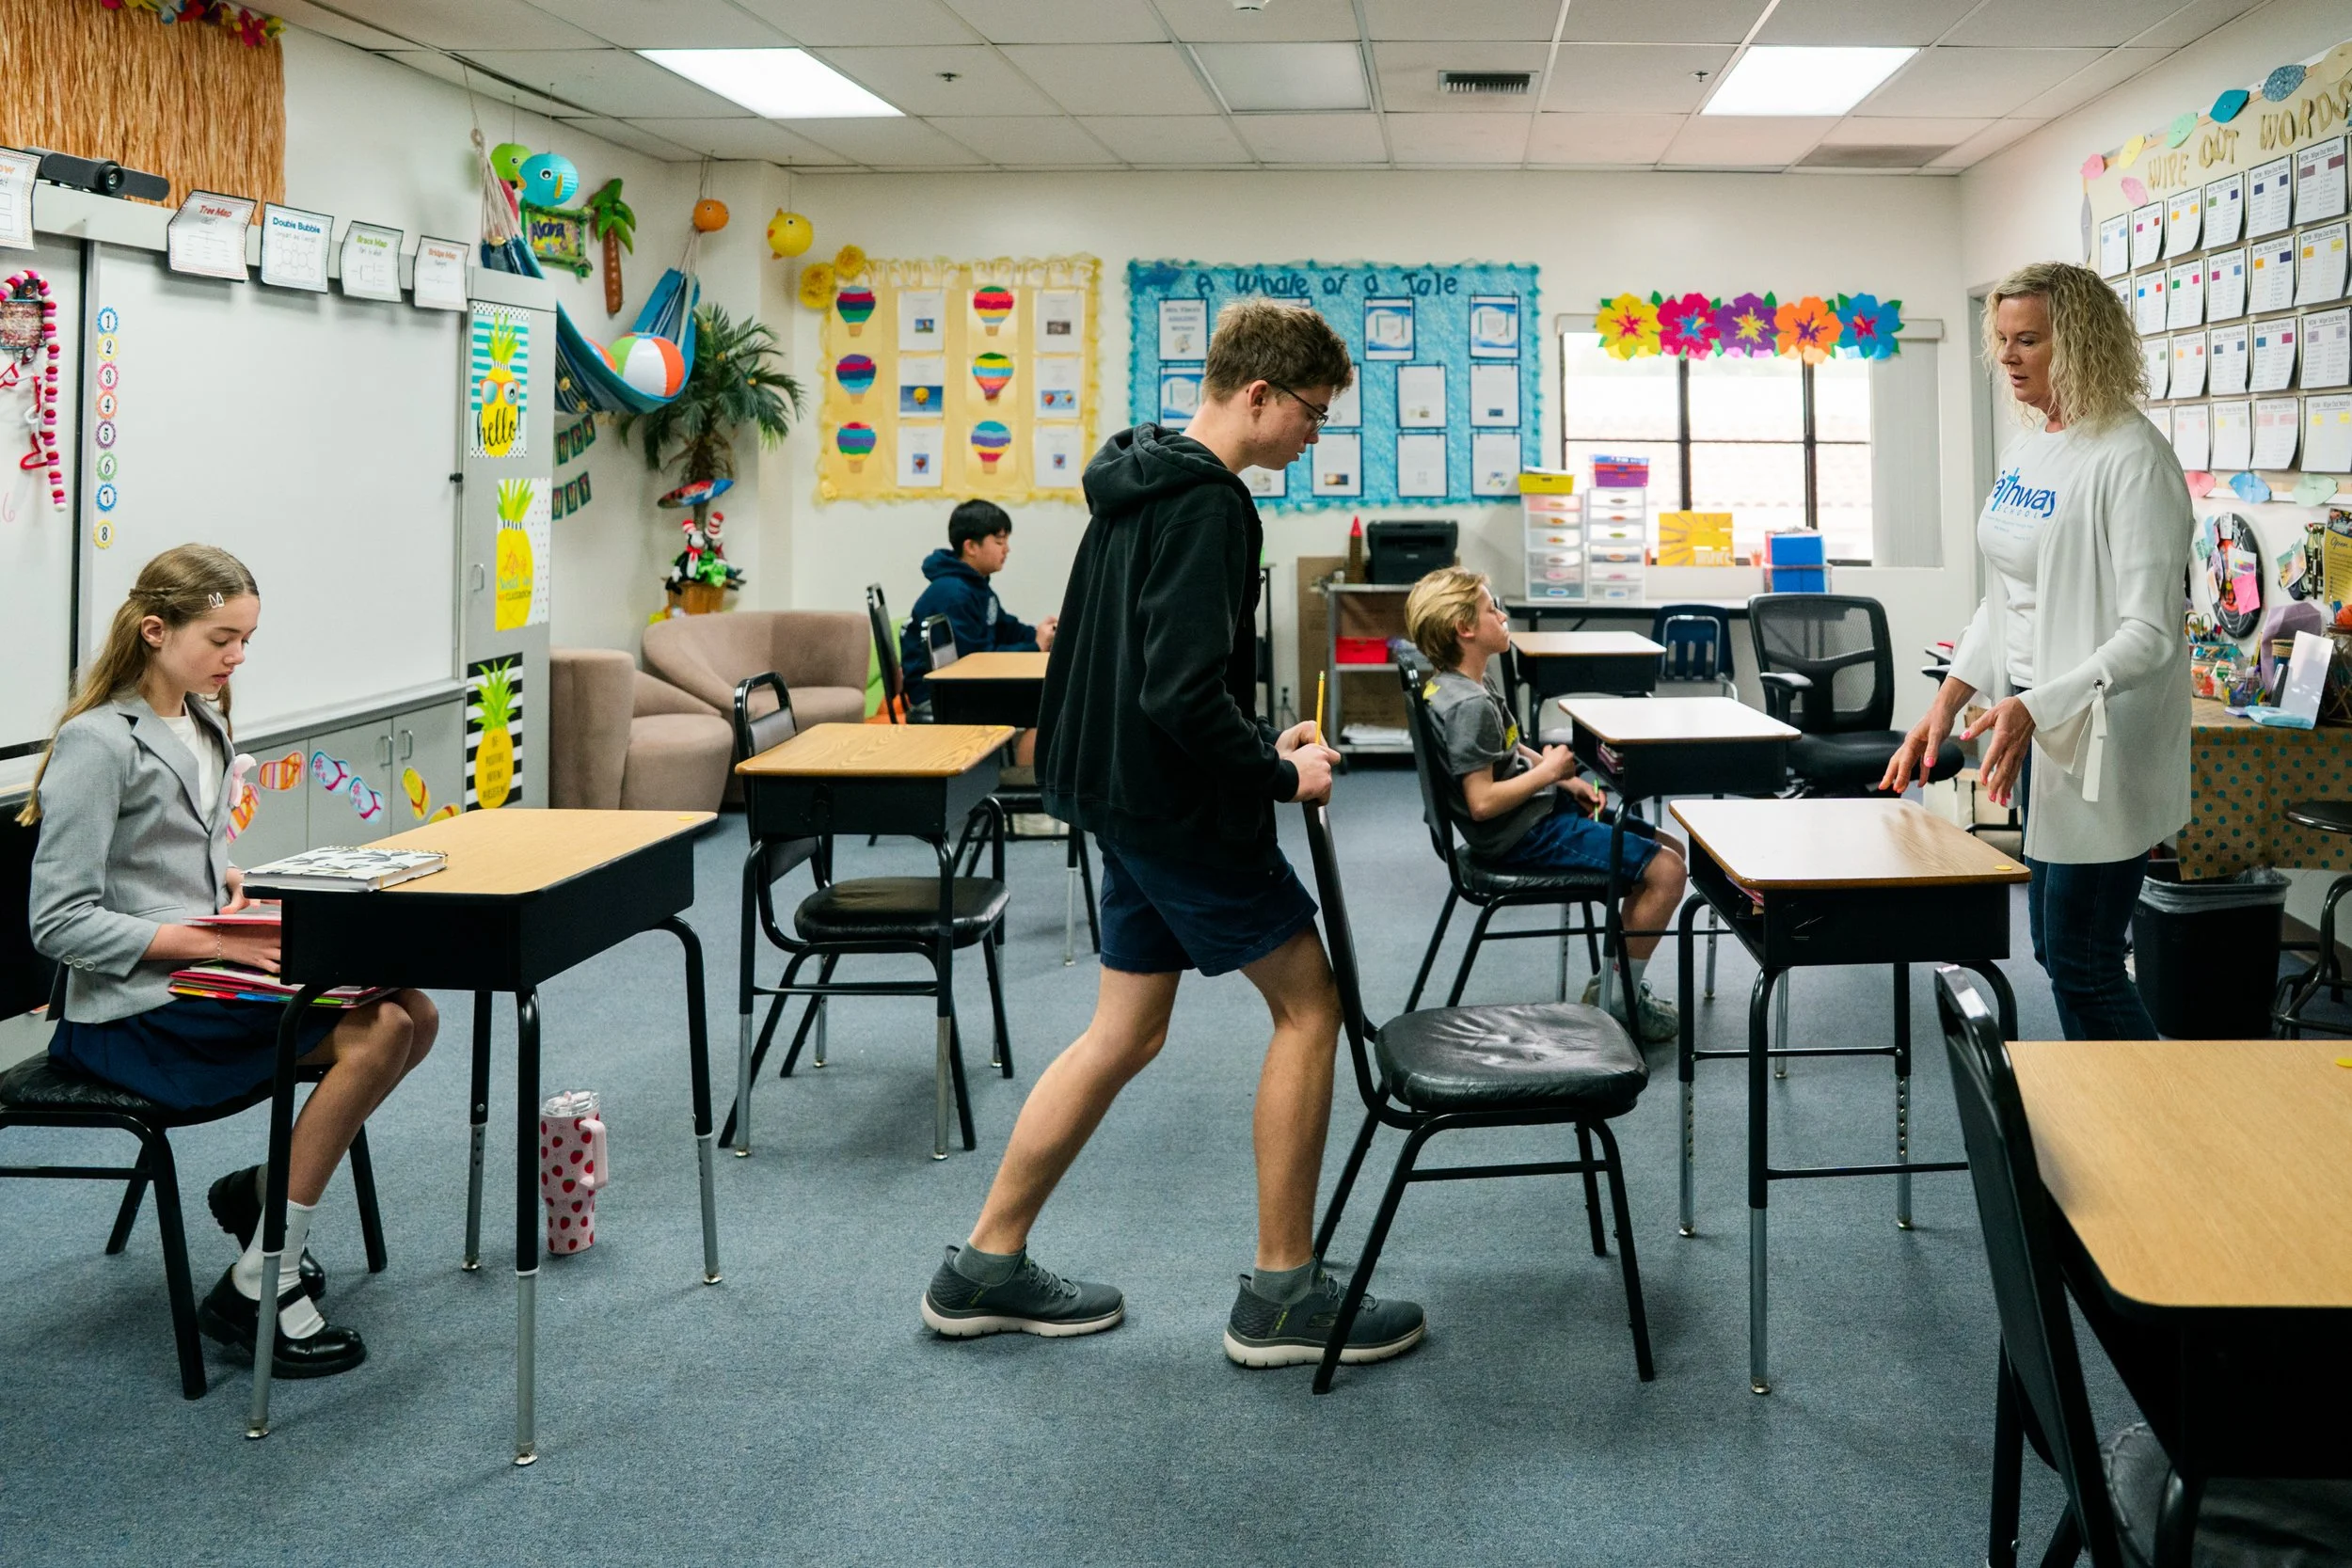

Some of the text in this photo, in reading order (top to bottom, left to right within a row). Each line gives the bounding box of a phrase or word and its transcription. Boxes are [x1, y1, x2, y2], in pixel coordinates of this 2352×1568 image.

[2148, 79, 2352, 190] WIPE OUT WORDS
[199, 204, 232, 218] Tree Map
[272, 216, 321, 233] Double Bubble
[374, 238, 389, 248] Map
[1195, 272, 1458, 297] A Whale of a Tale
[105, 314, 111, 329] 1
[105, 340, 112, 355] 2
[105, 370, 112, 385] 3
[103, 398, 110, 412] 4
[476, 405, 521, 447] hello!
[103, 427, 109, 441] 5
[103, 459, 110, 474] 6
[103, 489, 109, 504] 7
[1992, 467, 2056, 518] athway
[102, 526, 108, 541] 8
